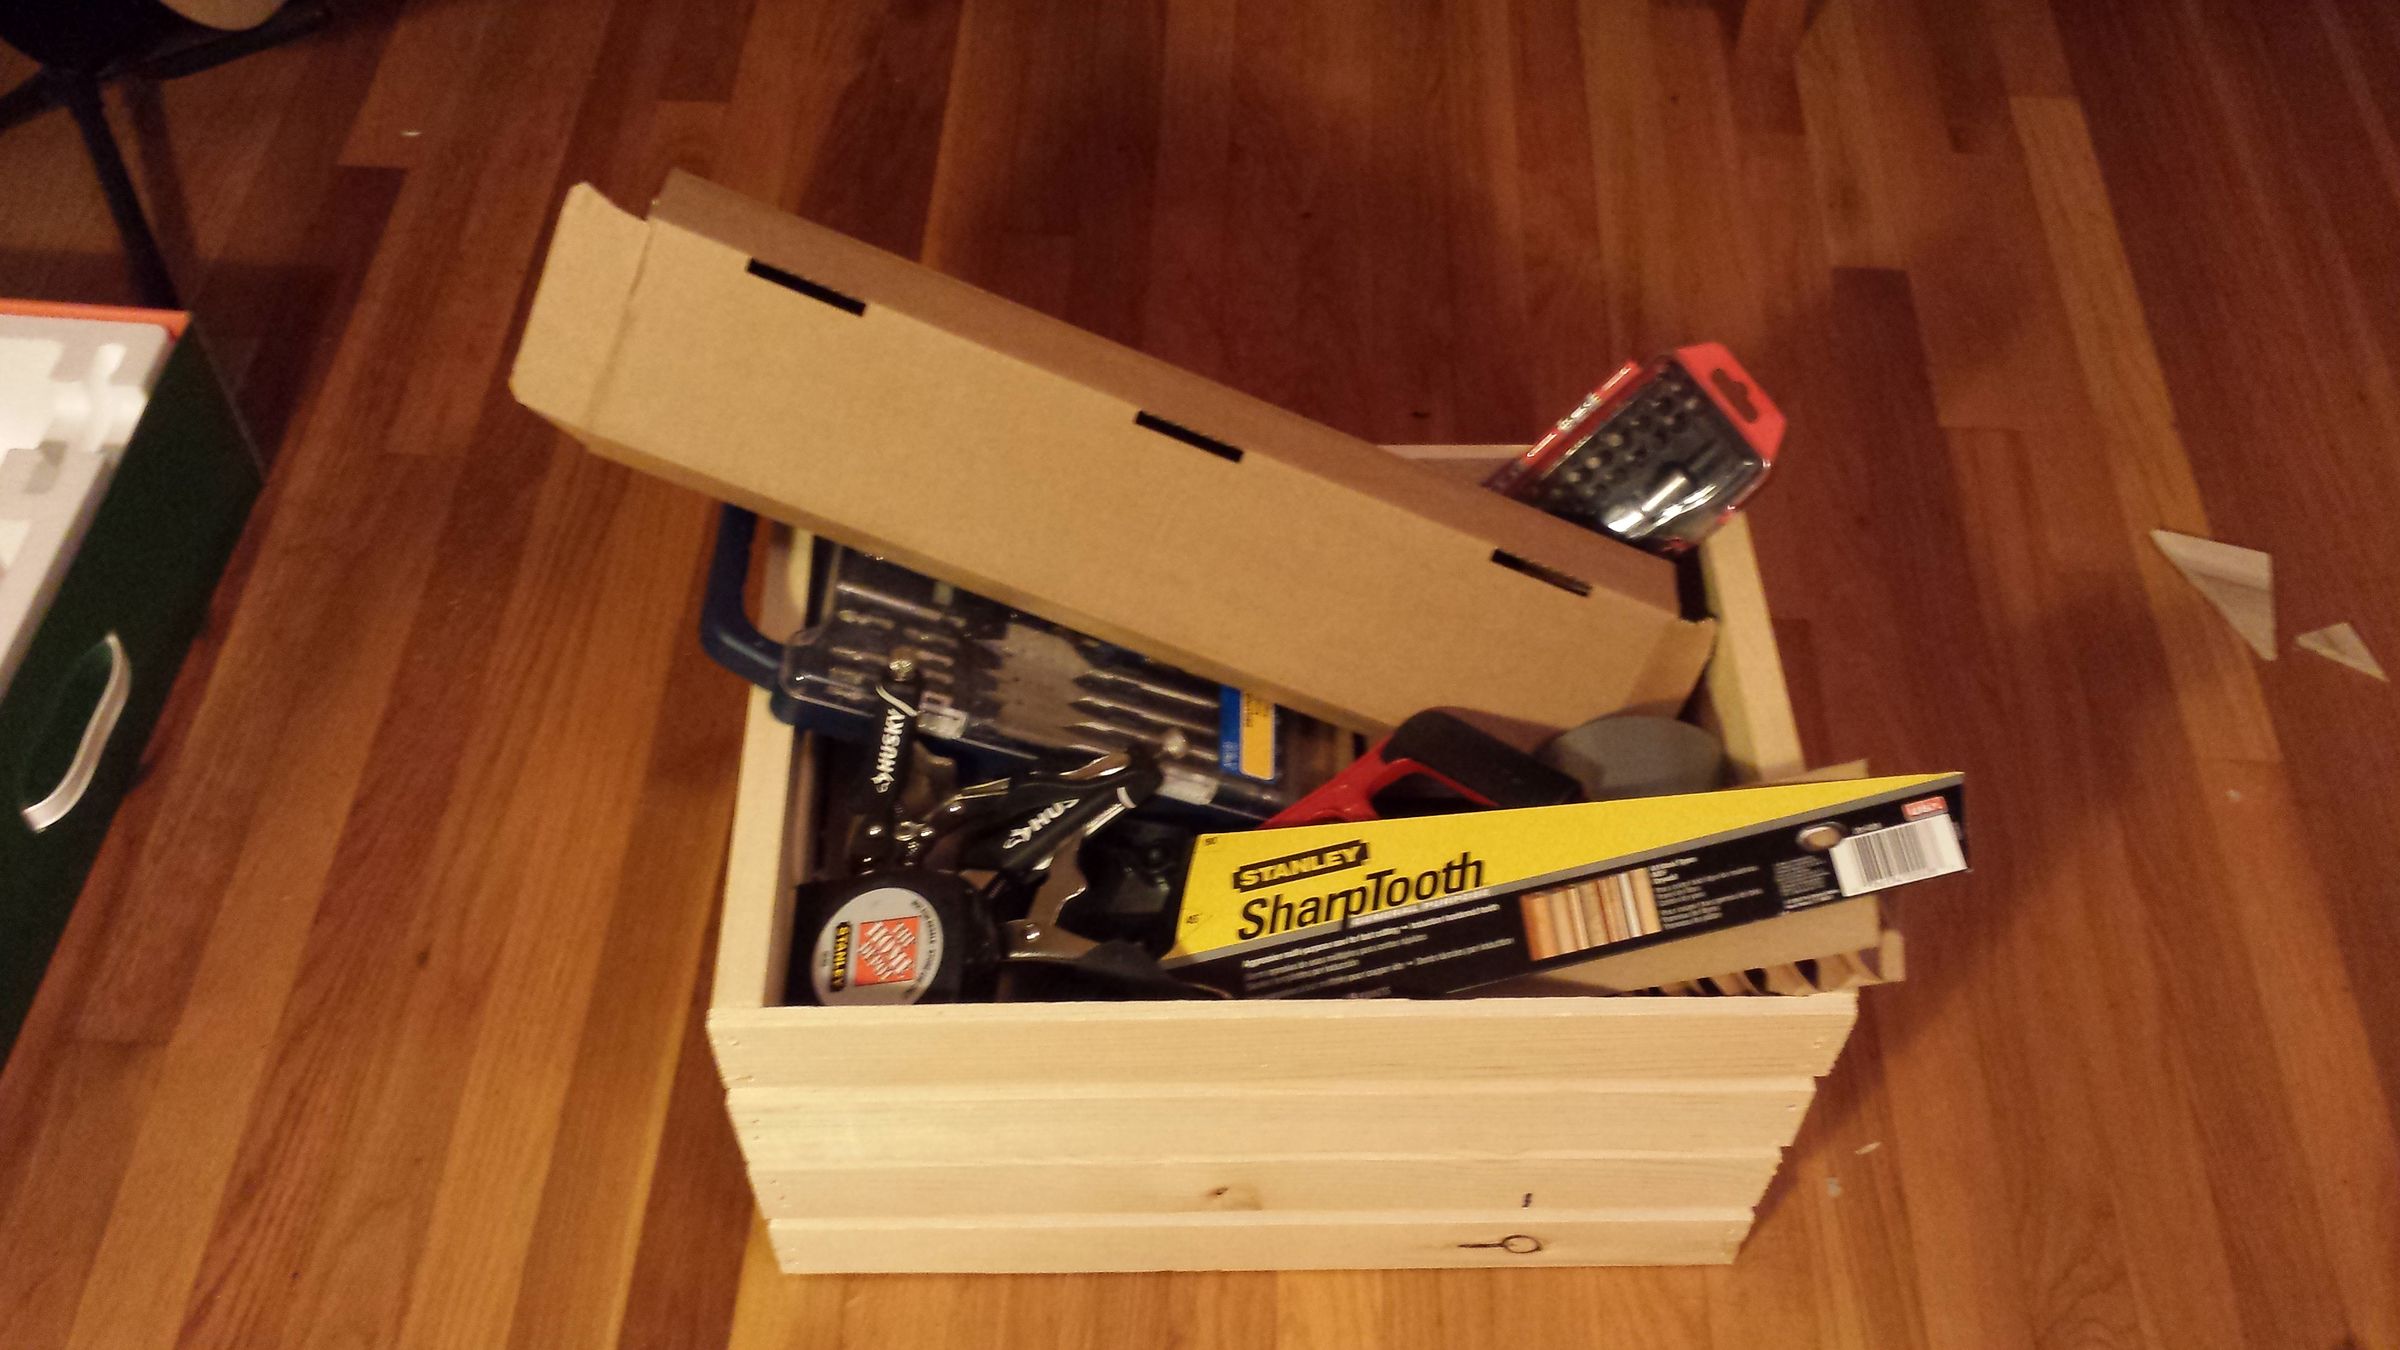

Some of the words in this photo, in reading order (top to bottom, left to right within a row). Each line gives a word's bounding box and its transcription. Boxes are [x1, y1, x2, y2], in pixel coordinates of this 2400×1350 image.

[876, 708, 904, 774] HUSKY
[1238, 851, 1486, 941] SharpTooth
[1239, 847, 1361, 886] STANLEY
[832, 926, 850, 987] STANLEY
